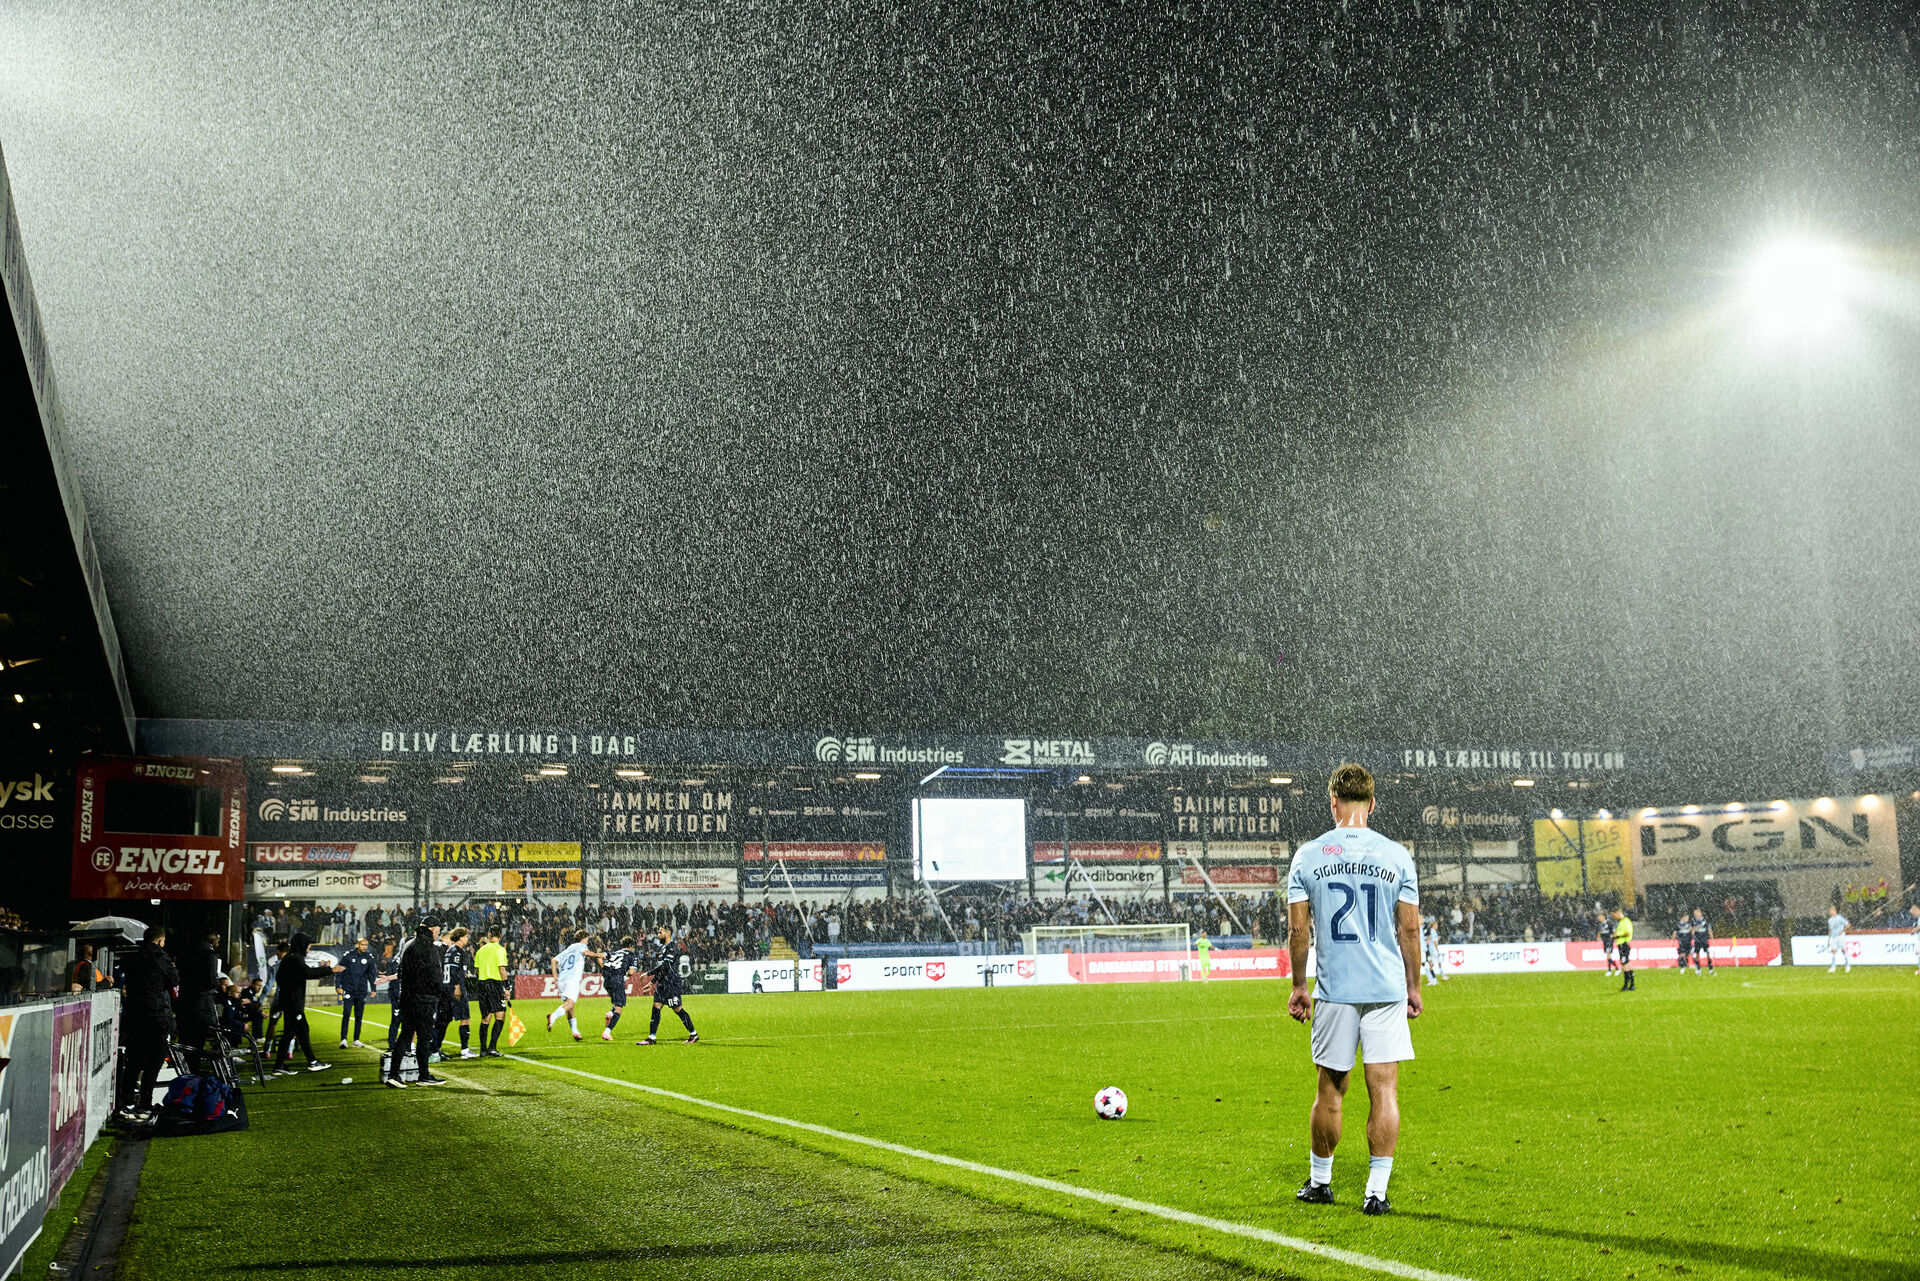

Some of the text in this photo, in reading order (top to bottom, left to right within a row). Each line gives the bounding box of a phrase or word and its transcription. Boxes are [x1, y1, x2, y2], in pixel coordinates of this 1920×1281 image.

[381, 731, 635, 755] BLIV LÆRLING I DAG
[1033, 740, 1095, 757] METAL
[845, 745, 964, 763] SM Industries
[1169, 749, 1268, 767] AH Industries
[1405, 751, 1437, 767] FRA
[1446, 751, 1521, 769] LÆRLING
[1531, 752, 1555, 769] TIL
[145, 764, 195, 780] ENGEL
[702, 792, 732, 812] OM
[1258, 796, 1283, 814] OM
[80, 788, 94, 844] ENGEL
[229, 797, 241, 849] ENGEL
[288, 806, 407, 822] SM Industries
[603, 813, 728, 833] FREMTIDEN
[1177, 815, 1280, 834] FRMTIDEN
[1640, 813, 1870, 857] PGN
[115, 847, 225, 875] ENGEL
[255, 846, 303, 862] FUGE
[429, 843, 523, 862] GRASSAT
[272, 876, 320, 888] hummel
[325, 876, 361, 886] SPORT
[632, 870, 661, 884] MAD
[1313, 862, 1396, 884] SIGURGEIRSSON
[125, 877, 193, 892] Workwear
[1327, 881, 1378, 944] 21
[883, 965, 923, 977] SPORT
